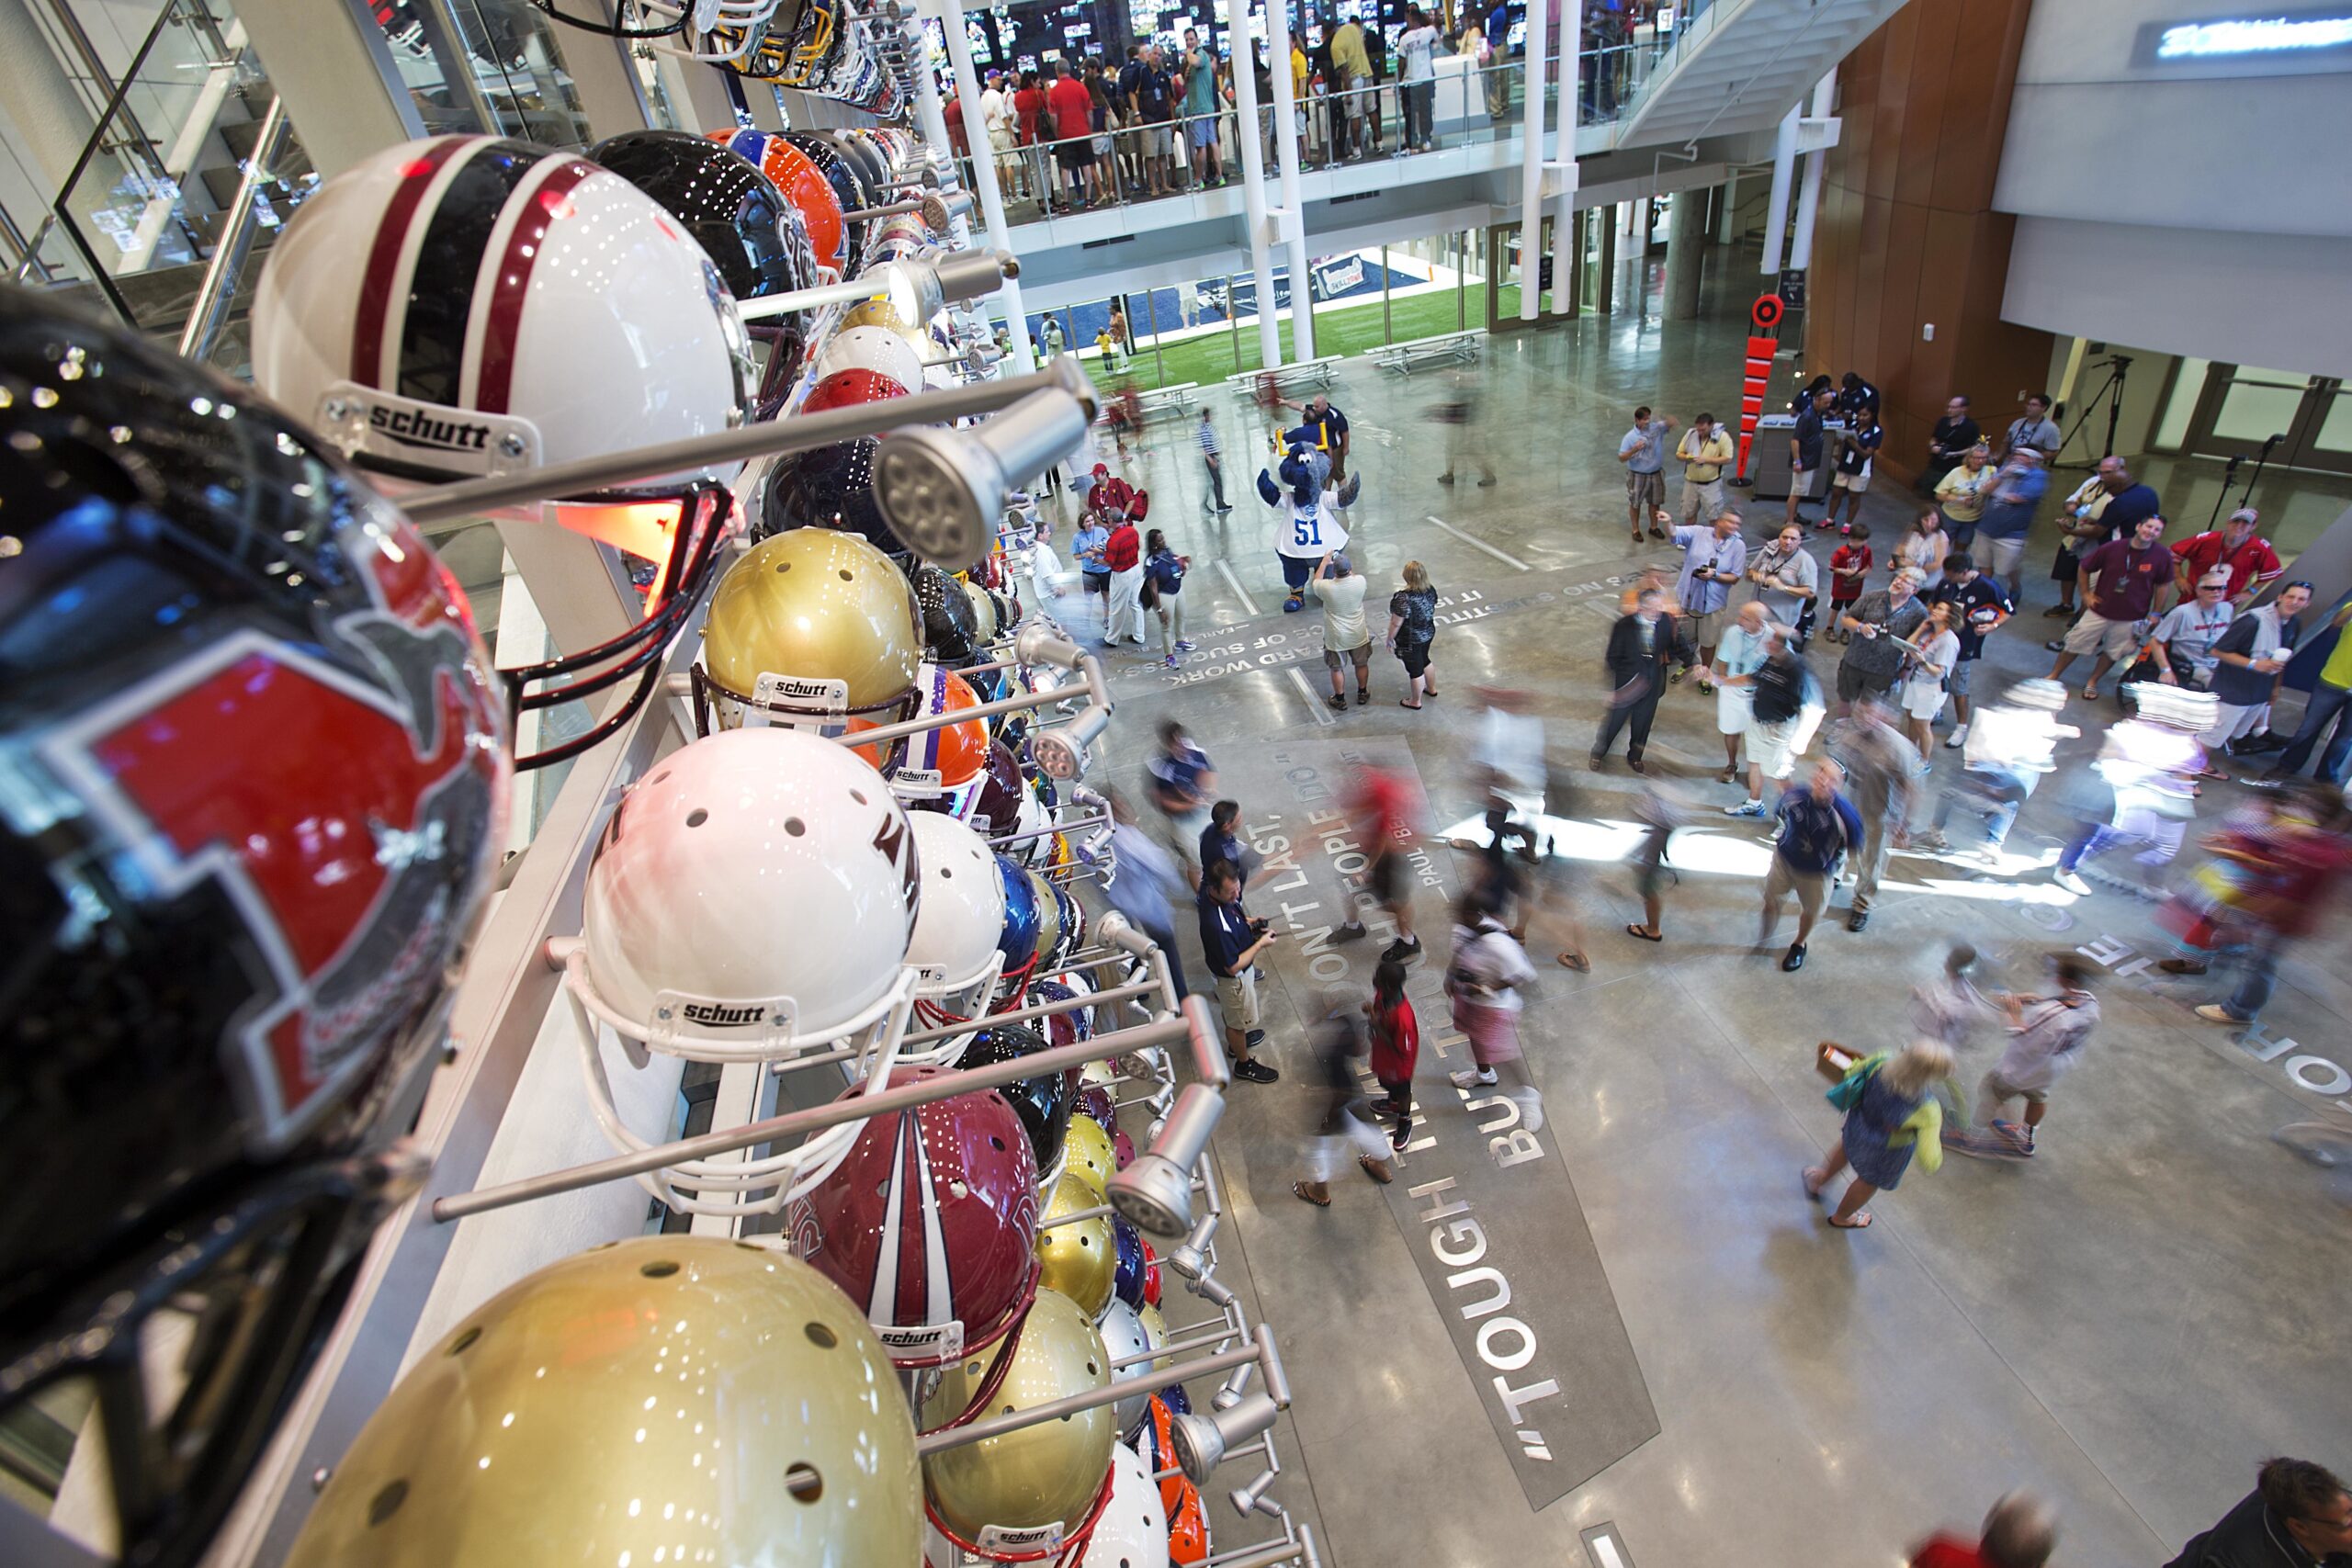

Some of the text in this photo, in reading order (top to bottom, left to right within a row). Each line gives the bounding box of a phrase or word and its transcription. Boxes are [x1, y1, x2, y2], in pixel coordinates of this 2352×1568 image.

[369, 404, 490, 449] schutt
[1295, 518, 1322, 546] 51
[1462, 590, 1483, 603] IT
[1563, 581, 1604, 596] NO
[1253, 634, 1286, 649] OF
[775, 682, 827, 698] schutt
[897, 770, 929, 783] schutt
[1245, 815, 1309, 893] LAST,
[684, 1004, 764, 1027] schutt
[881, 1332, 941, 1348] schutt
[1000, 1530, 1047, 1544] schutt
